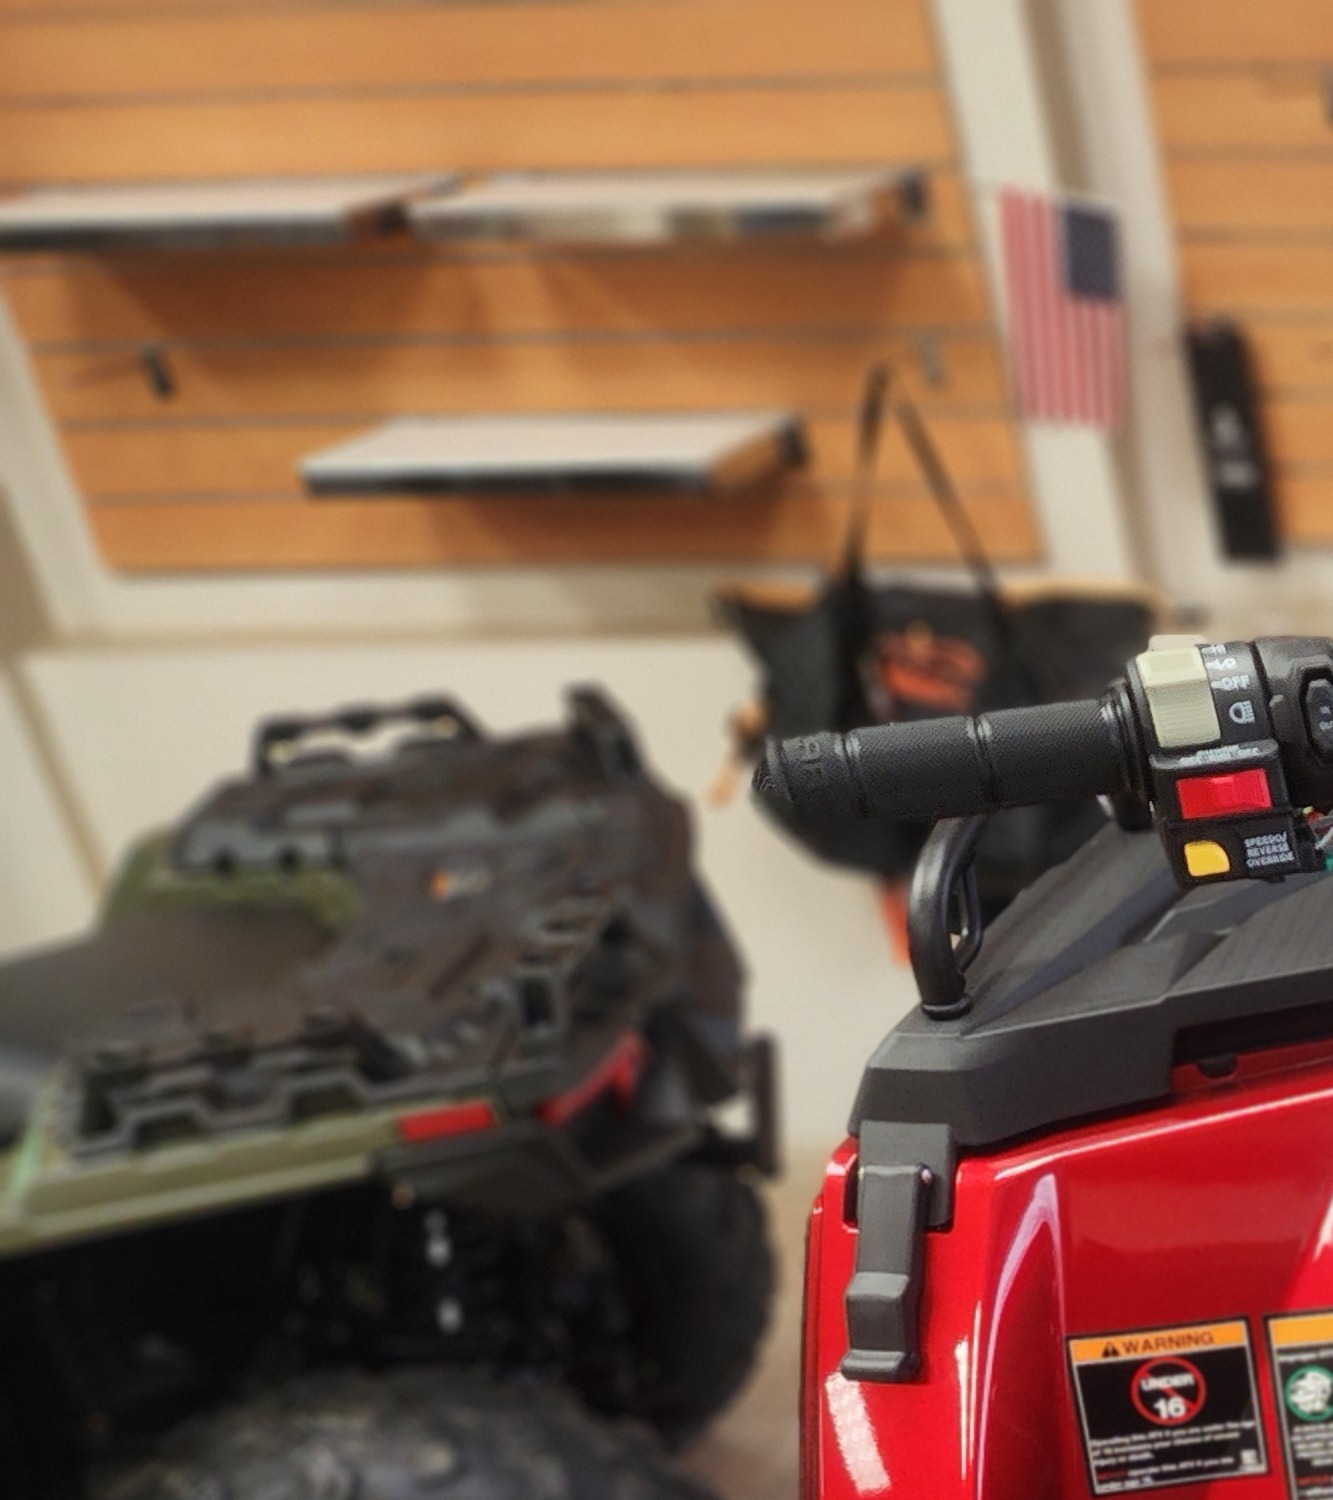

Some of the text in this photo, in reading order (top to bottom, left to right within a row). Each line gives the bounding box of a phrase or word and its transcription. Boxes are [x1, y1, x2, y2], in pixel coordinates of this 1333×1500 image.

[1222, 675, 1250, 690] OFF
[1121, 1331, 1214, 1352] WARNING
[1140, 1372, 1196, 1392] UNDER
[1153, 1395, 1187, 1420] 16
